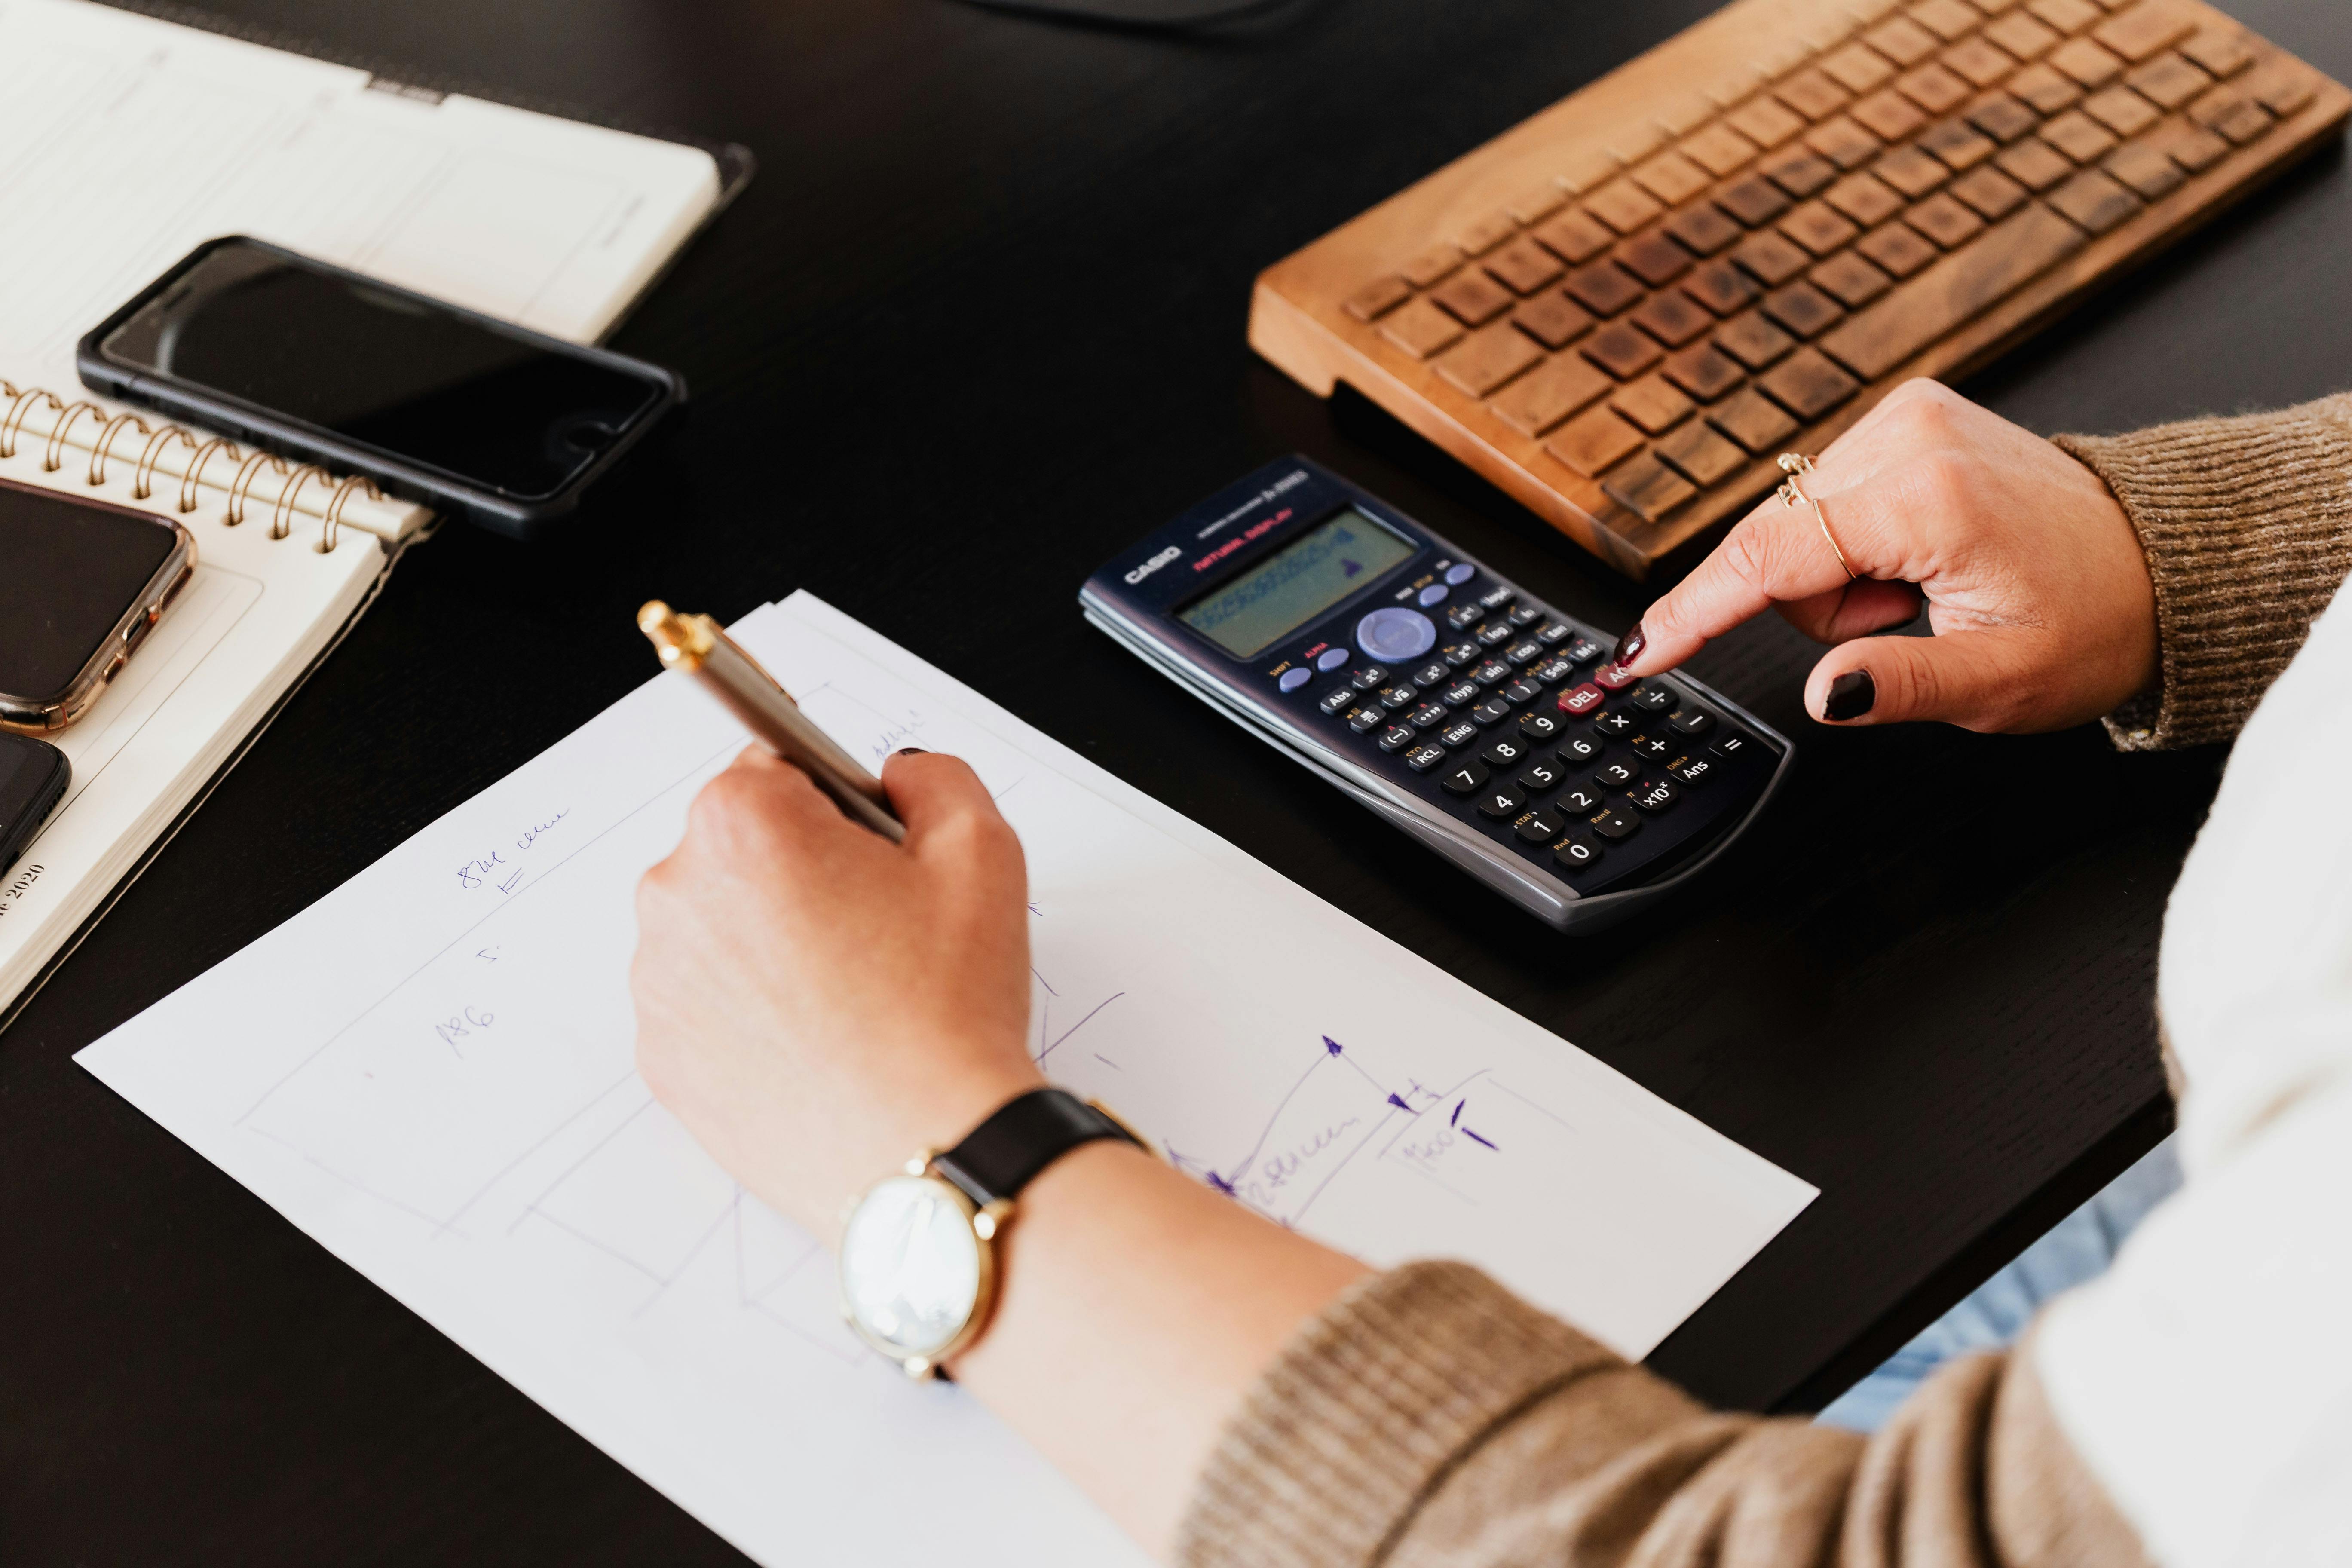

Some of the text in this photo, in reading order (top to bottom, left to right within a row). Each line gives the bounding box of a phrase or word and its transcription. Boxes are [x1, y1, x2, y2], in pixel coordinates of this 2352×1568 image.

[1124, 546, 1182, 585] CASIO
[1485, 666, 1504, 678] sin
[1329, 691, 1350, 706] Abs
[1450, 685, 1473, 699] hyp
[1568, 691, 1598, 707] DEL
[1536, 717, 1554, 731] 9
[1448, 725, 1472, 741] ENG
[1497, 744, 1516, 756] 8
[1573, 740, 1591, 753] 6
[1416, 749, 1439, 763] RCL
[1456, 770, 1474, 784] 7
[1533, 767, 1552, 781] 5
[1609, 766, 1629, 779] 3
[1683, 761, 1709, 779] Ans
[1496, 795, 1513, 808] 4
[1571, 792, 1592, 806] 2
[1534, 821, 1551, 832] 1
[1553, 838, 1571, 850] Rnd
[1570, 845, 1589, 858] 0
[5, 864, 45, 899] 2020
